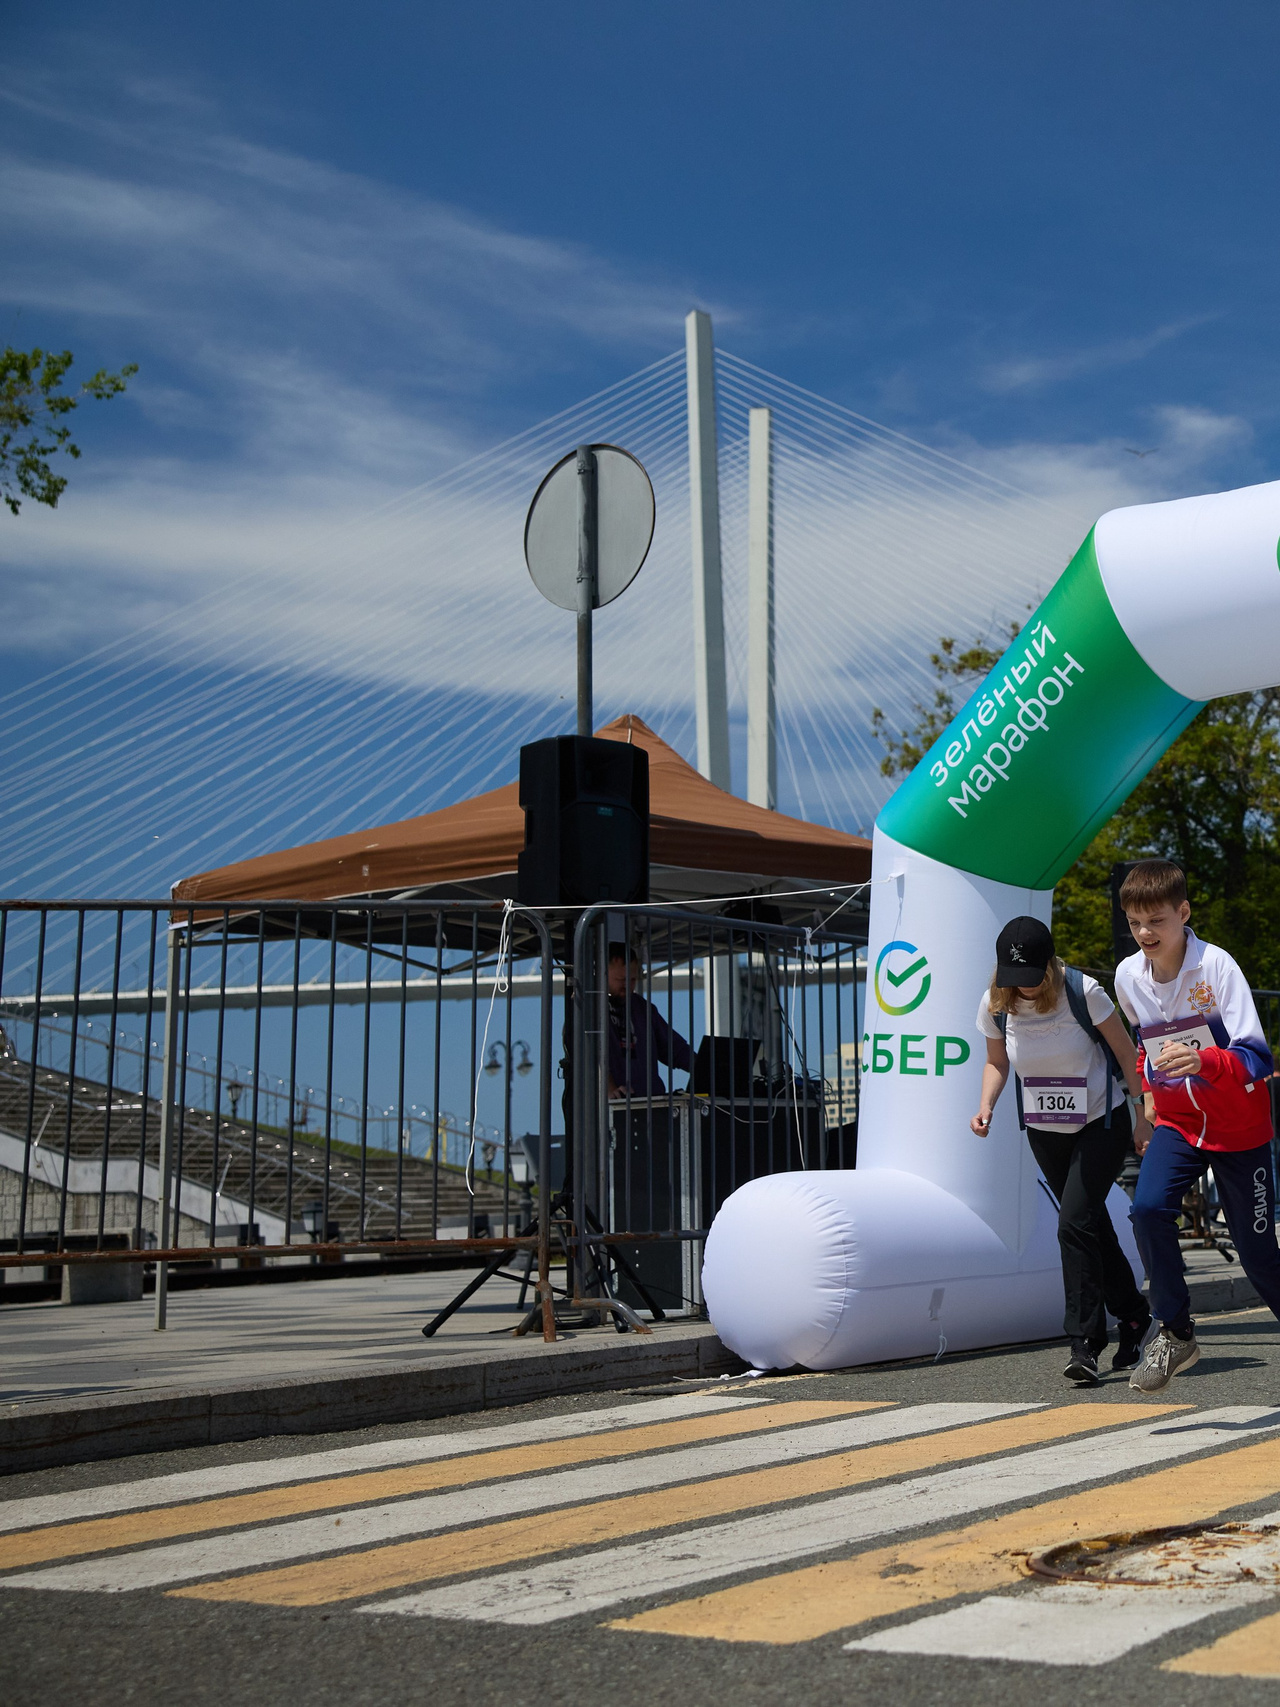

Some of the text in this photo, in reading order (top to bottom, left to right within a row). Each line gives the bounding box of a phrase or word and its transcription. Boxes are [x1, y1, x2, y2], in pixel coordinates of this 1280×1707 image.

[929, 620, 1057, 788] зелёный
[947, 651, 1086, 819] марафон
[1037, 1095, 1076, 1111] 1304
[1253, 1166, 1268, 1234] САМБО
